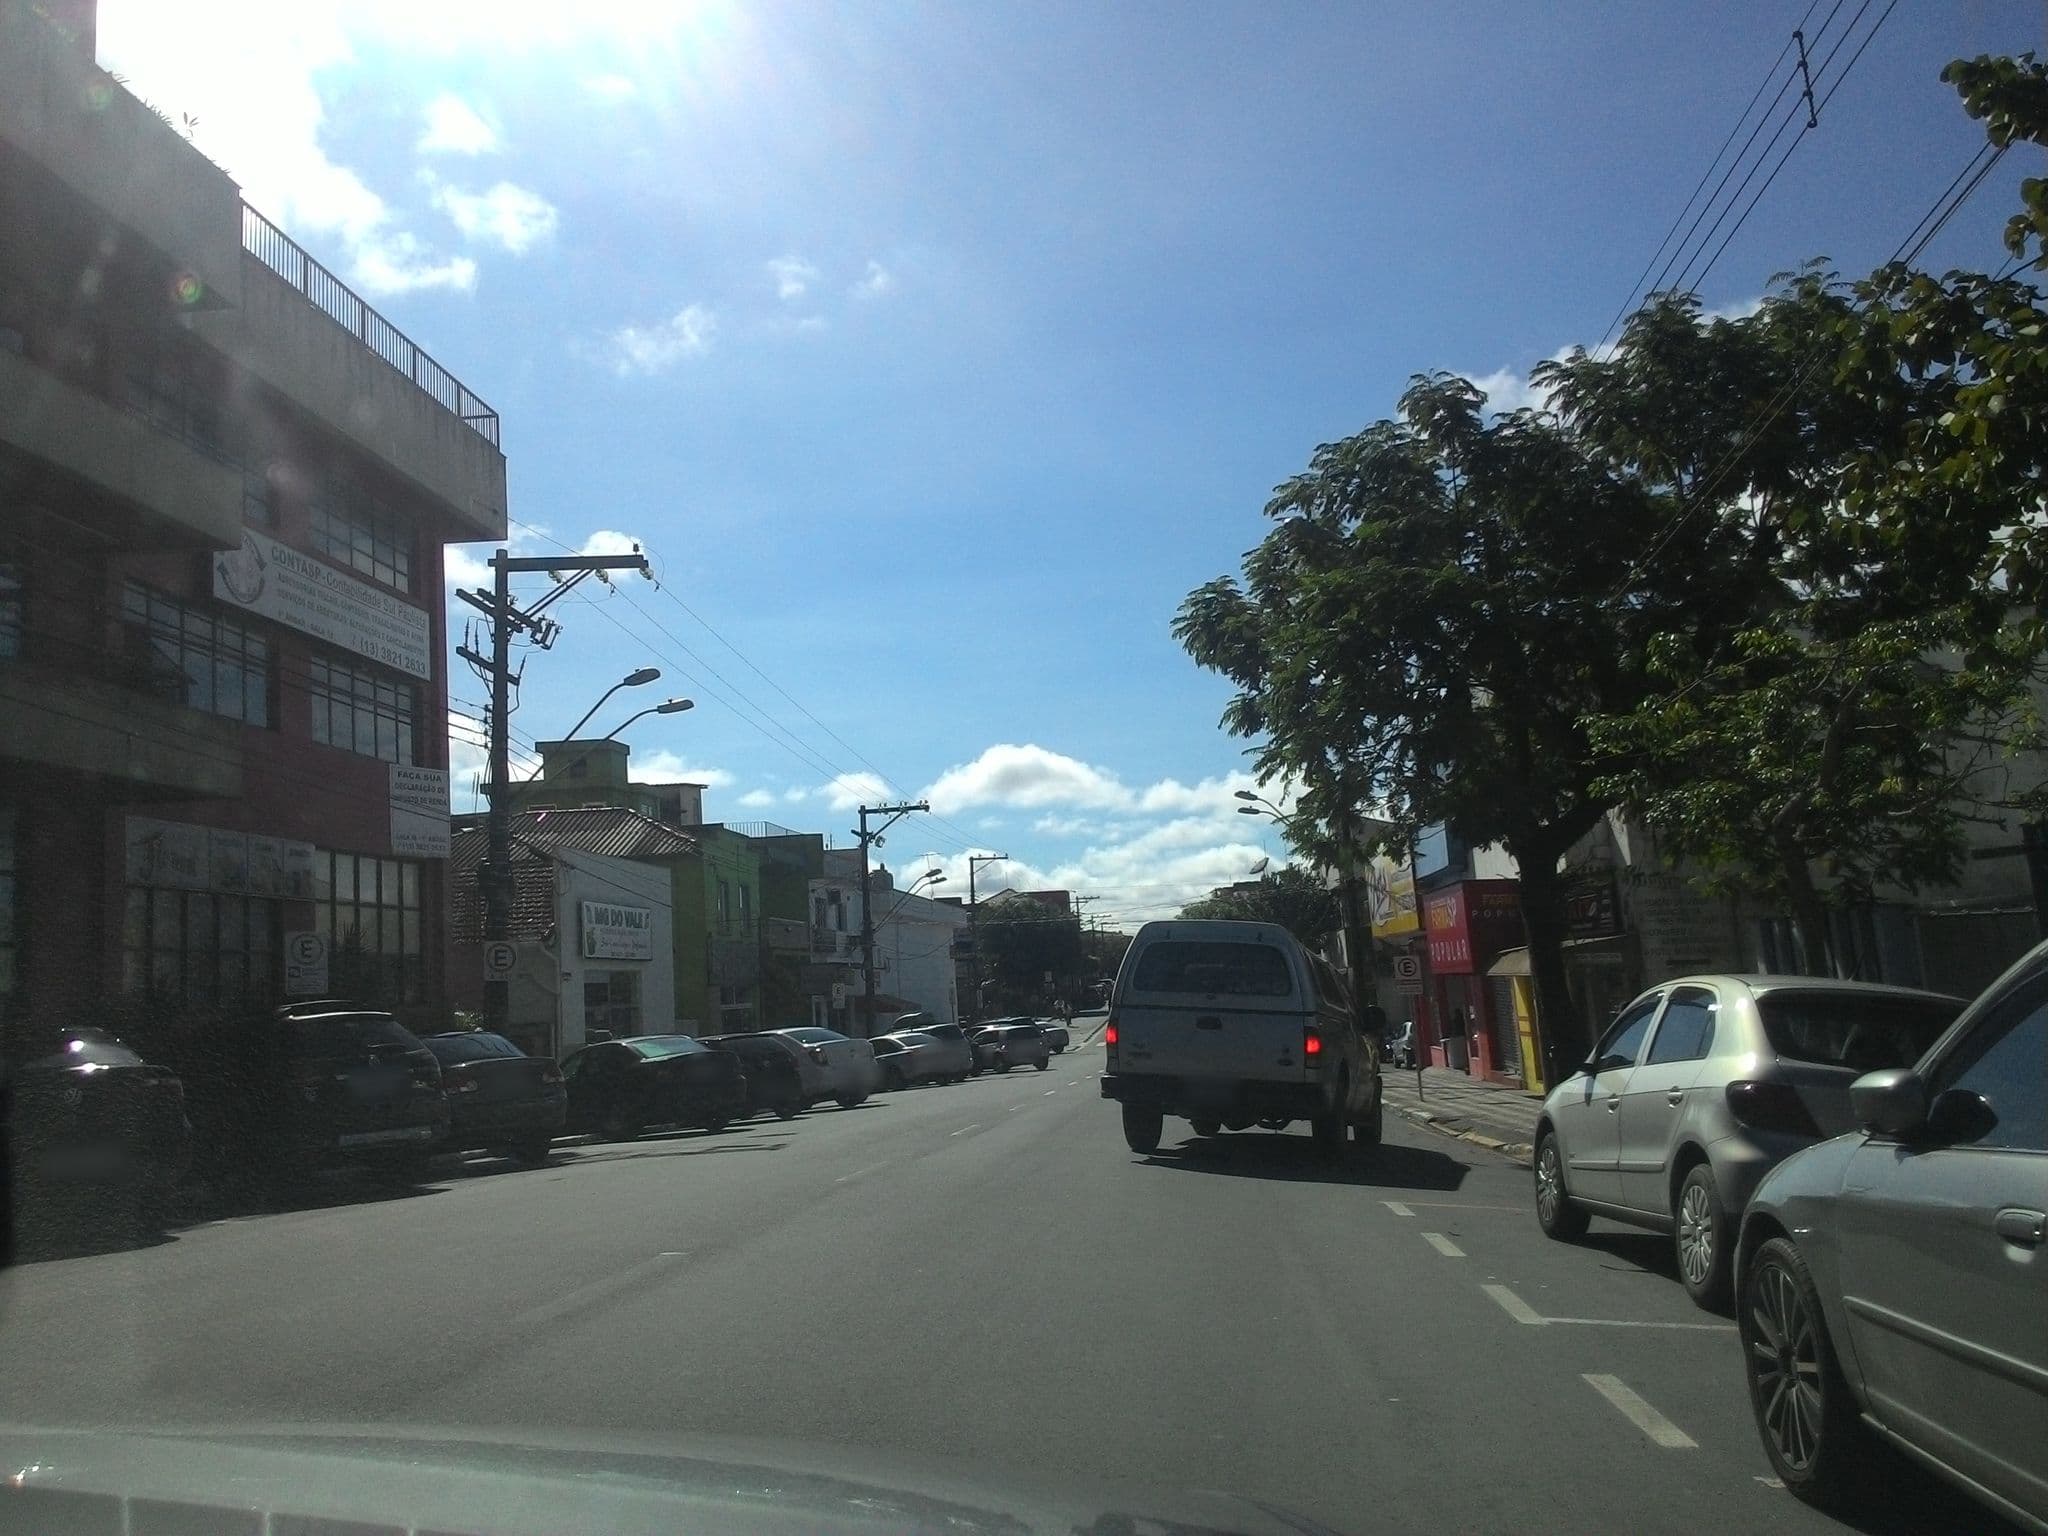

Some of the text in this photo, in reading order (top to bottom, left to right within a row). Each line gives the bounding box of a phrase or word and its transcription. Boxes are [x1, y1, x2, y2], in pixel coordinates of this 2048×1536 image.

[271, 546, 320, 580] CONTASP
[326, 572, 382, 605] Contabilidade
[380, 645, 401, 666] 3821
[405, 654, 426, 675] 2633
[423, 773, 442, 782] SUA
[300, 940, 313, 959] E
[494, 949, 508, 967] E
[1431, 938, 1469, 961] POPULAR
[1403, 961, 1413, 973] E
